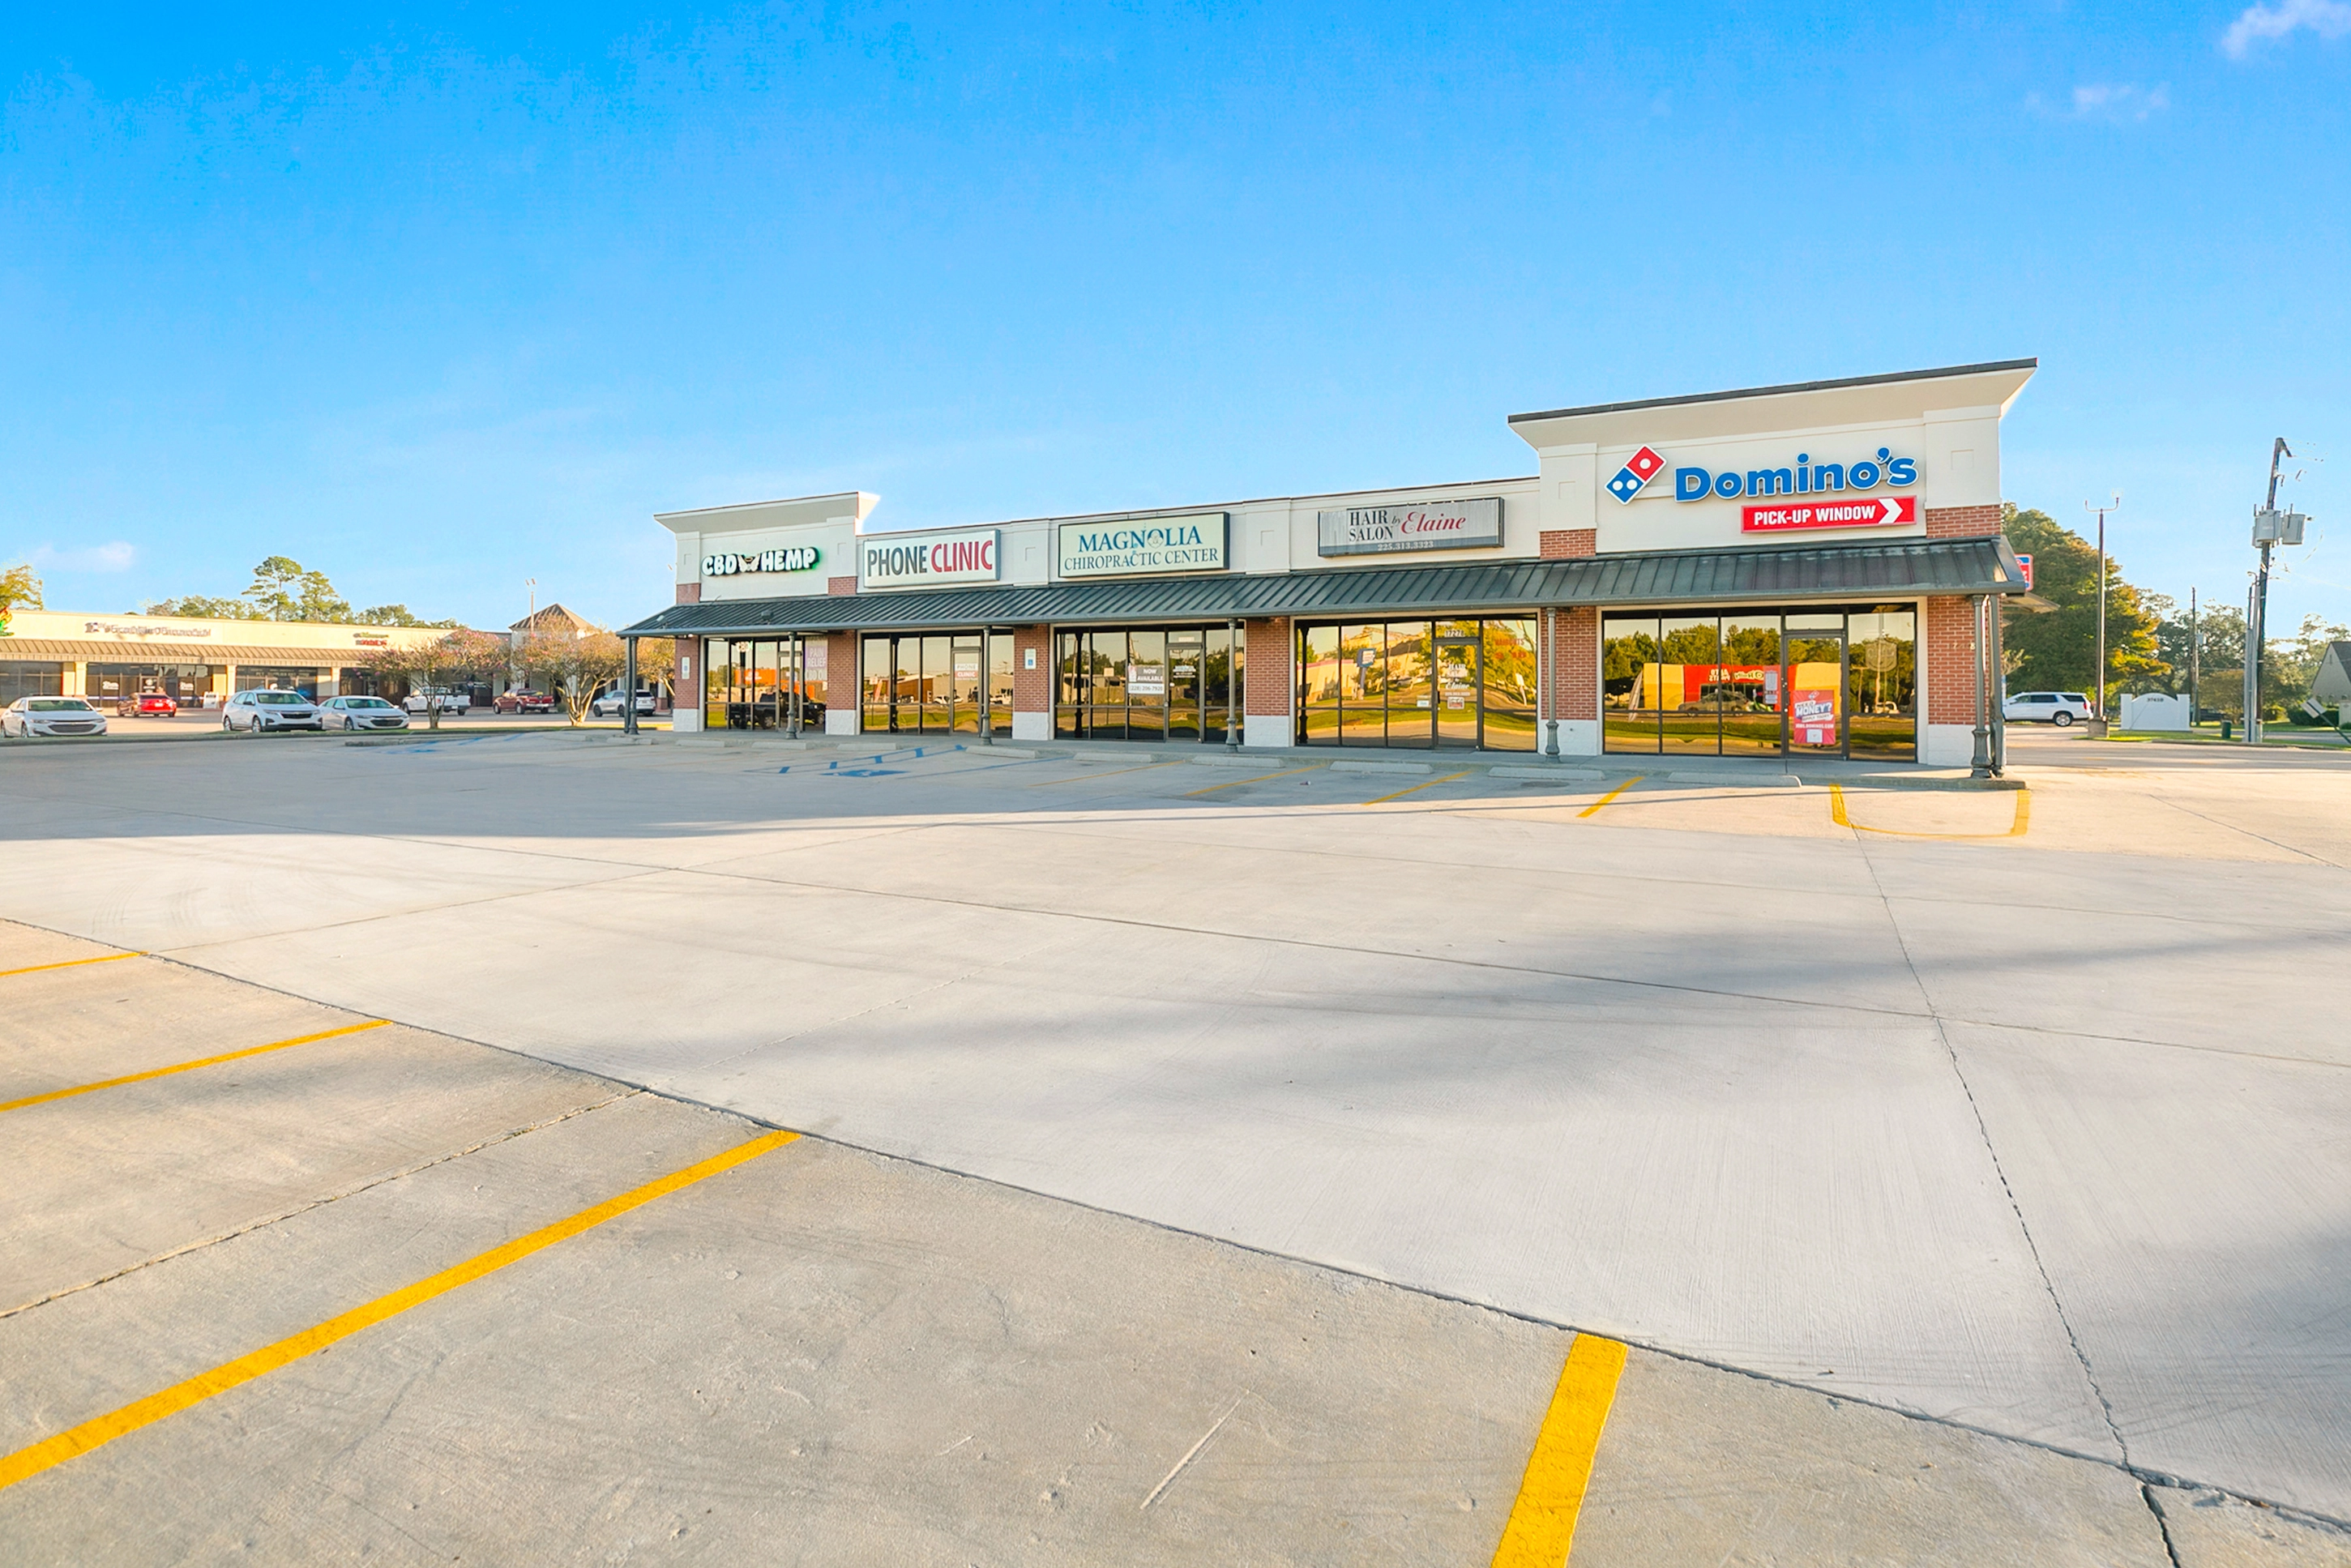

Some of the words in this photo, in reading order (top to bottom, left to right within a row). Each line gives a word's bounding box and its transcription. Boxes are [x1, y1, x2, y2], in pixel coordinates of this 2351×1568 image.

[1674, 446, 1918, 502] Domino's
[1349, 510, 1388, 526] HAIR
[1391, 515, 1402, 524] by
[1400, 511, 1466, 535] Elaine
[1754, 508, 1811, 525] PICK-UP
[1815, 506, 1876, 522] WINDOW
[1078, 526, 1203, 553] MAGNOLIA
[1349, 526, 1394, 541] SALON
[701, 553, 738, 576] CBD
[761, 547, 819, 572] HEMP
[868, 545, 927, 577] PHONE
[931, 540, 993, 573] CLINIC
[1064, 553, 1161, 570] CHIROPRACTIC
[1165, 548, 1218, 564] CENTER
[806, 657, 827, 667] RELIEF
[810, 647, 824, 657] PAIN
[1796, 702, 1832, 716] MONEY?
